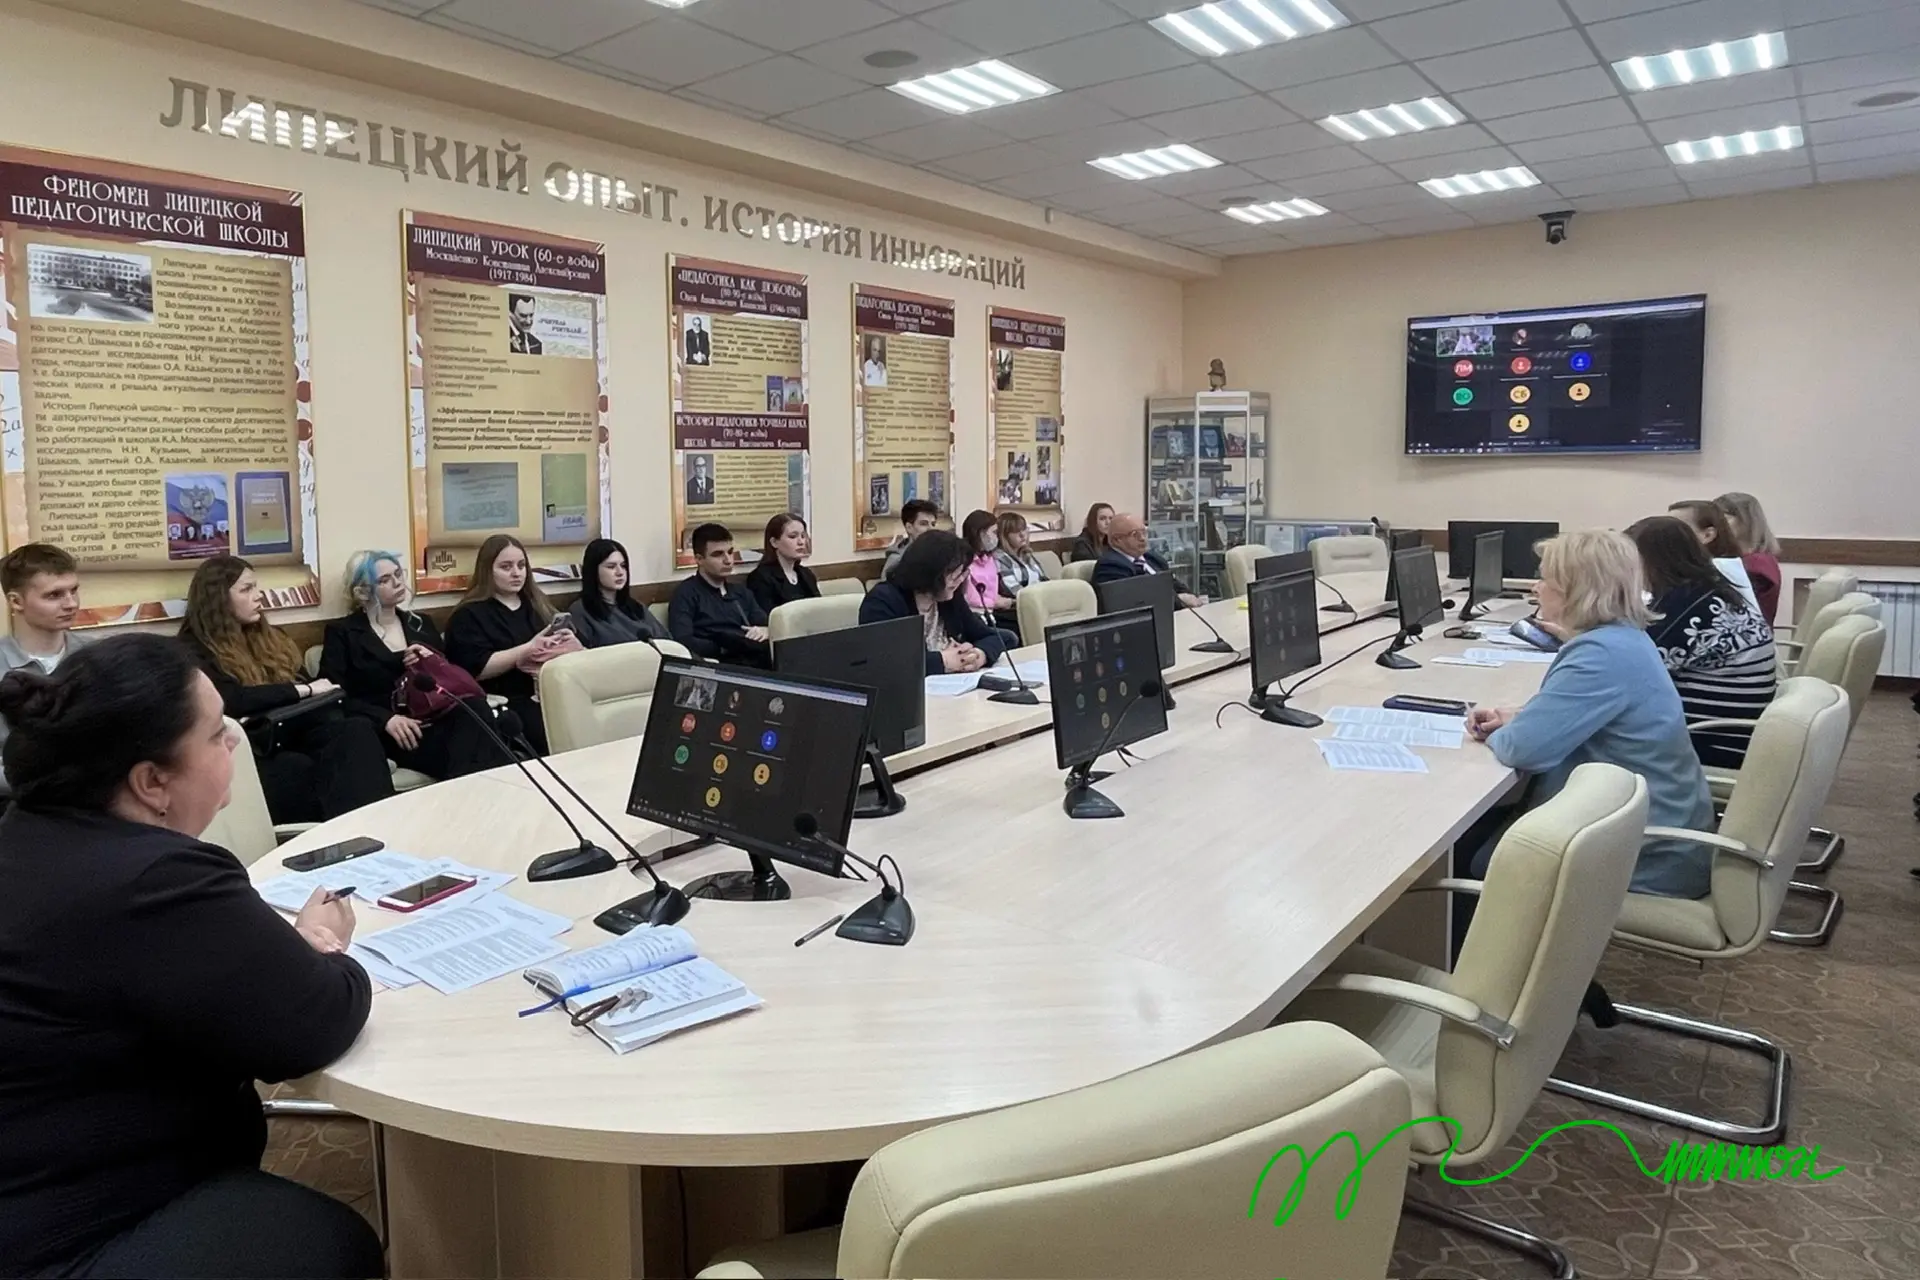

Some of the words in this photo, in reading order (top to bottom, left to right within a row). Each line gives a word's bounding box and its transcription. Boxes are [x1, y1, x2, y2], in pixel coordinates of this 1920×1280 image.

[44, 174, 149, 207] ФЕНОМЕН
[164, 192, 262, 222] ЛИПЕЦКОЙ
[160, 77, 530, 196] ЛИПЕЦКИЙ
[544, 161, 689, 227] ОПЫТ.
[704, 196, 862, 258] ИСТОРИЯ
[870, 231, 1025, 290] ИННОВАЦИЙ
[12, 195, 204, 238] ПЕДАГОГИЧЕСКОЙ
[219, 223, 288, 249] ШКОЛЫ
[413, 228, 481, 252] ЛИПЕЦКИЙ
[491, 240, 529, 259] УРОК
[741, 278, 756, 291] КАК
